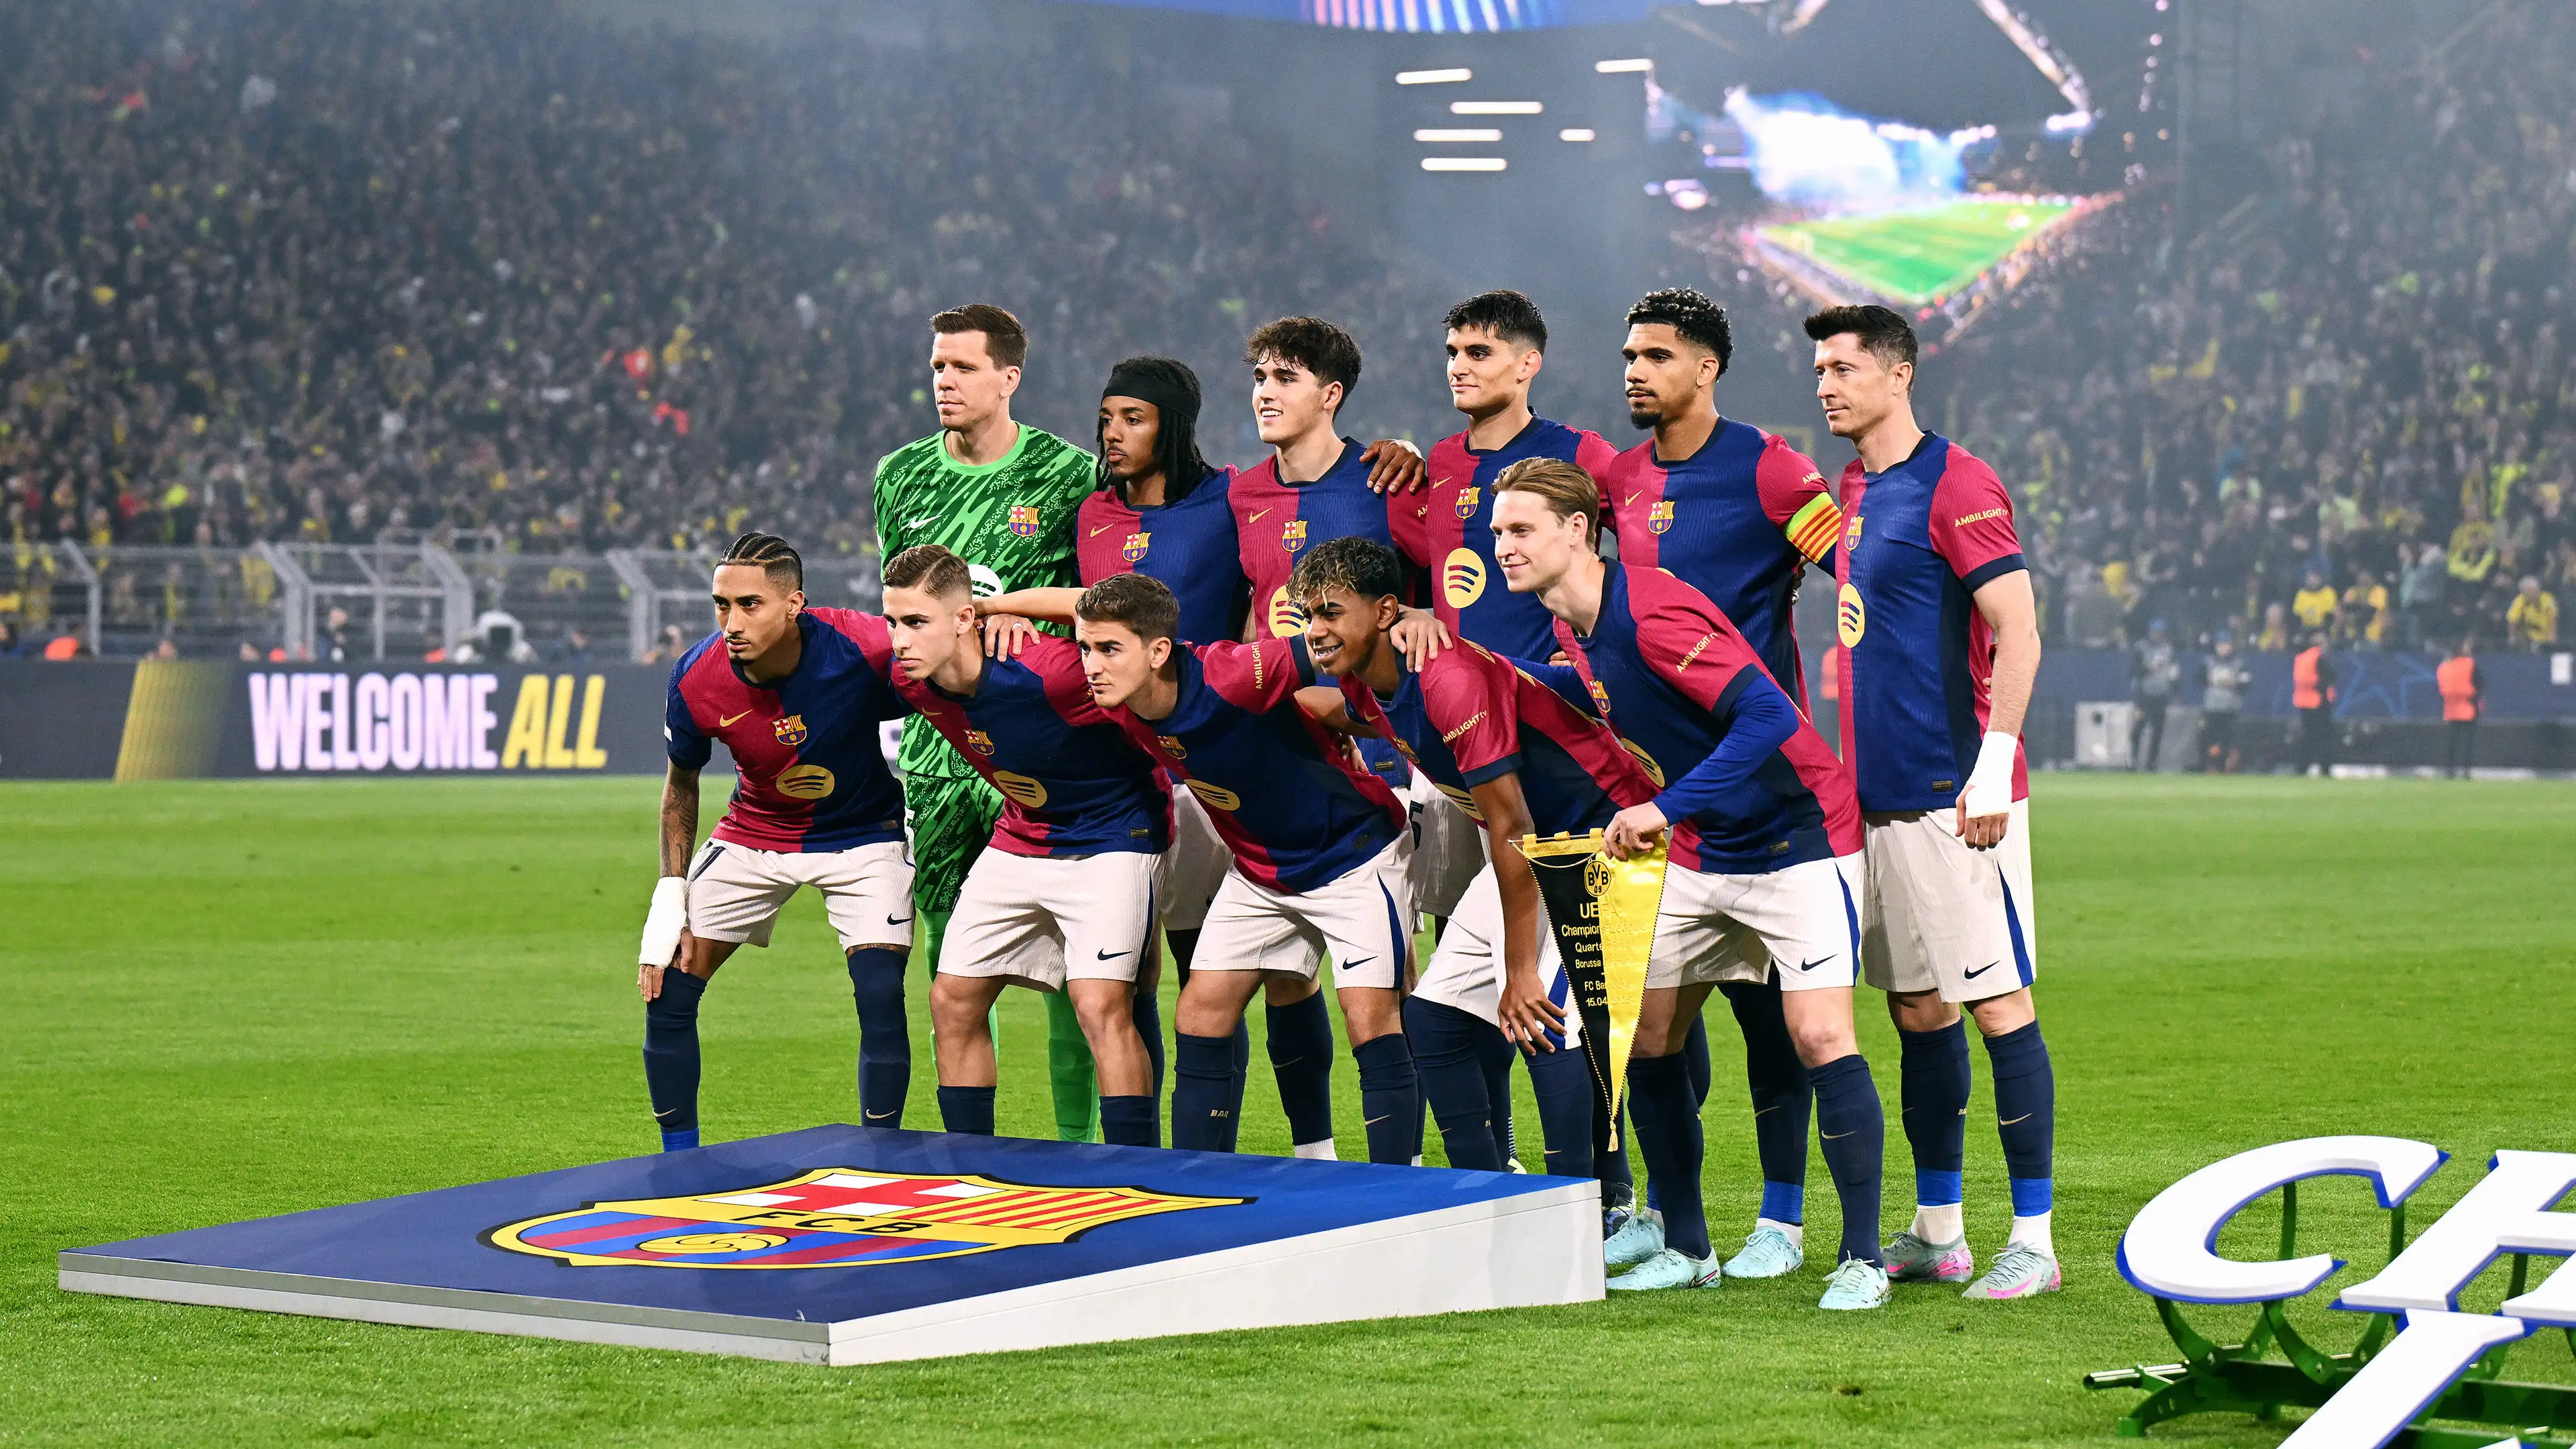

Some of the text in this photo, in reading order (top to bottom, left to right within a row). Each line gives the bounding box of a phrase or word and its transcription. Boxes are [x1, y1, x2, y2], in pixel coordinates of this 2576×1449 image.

[1955, 508, 2002, 528] AMBILIGHT
[1676, 635, 1711, 674] AMBILIGHT
[1251, 645, 1263, 690] AMBILIGHT
[248, 672, 608, 771] WELCOME ALL
[1479, 710, 1487, 718] tv
[1588, 864, 1609, 886] BVB
[1575, 959, 1601, 969] Borussia
[1585, 981, 1594, 991] FC
[729, 1211, 932, 1234] FCB
